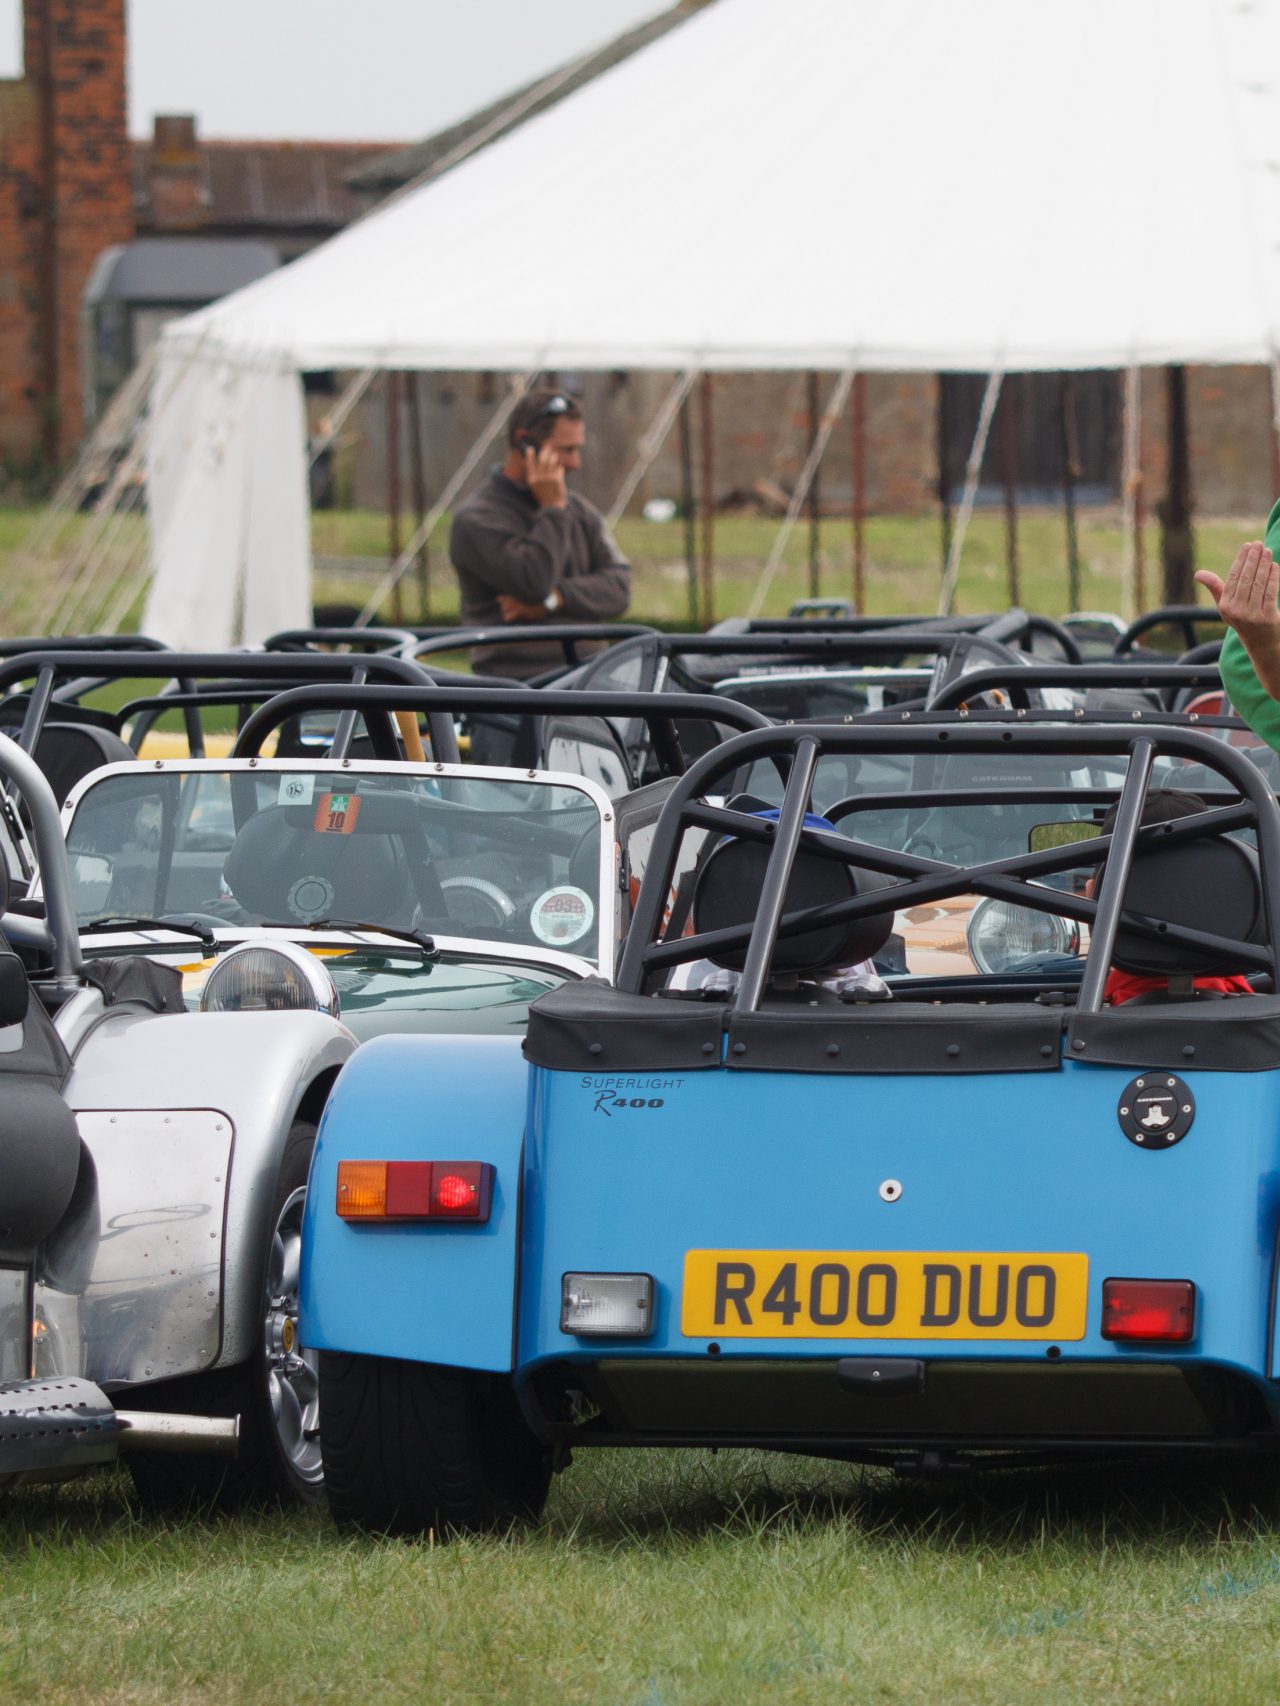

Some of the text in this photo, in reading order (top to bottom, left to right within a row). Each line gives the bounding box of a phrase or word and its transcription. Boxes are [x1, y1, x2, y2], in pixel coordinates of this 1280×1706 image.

[328, 812, 346, 828] 10
[580, 1076, 685, 1089] SUPERLIGHT
[593, 1089, 665, 1117] R400
[713, 1261, 1057, 1328] R400 DUO
